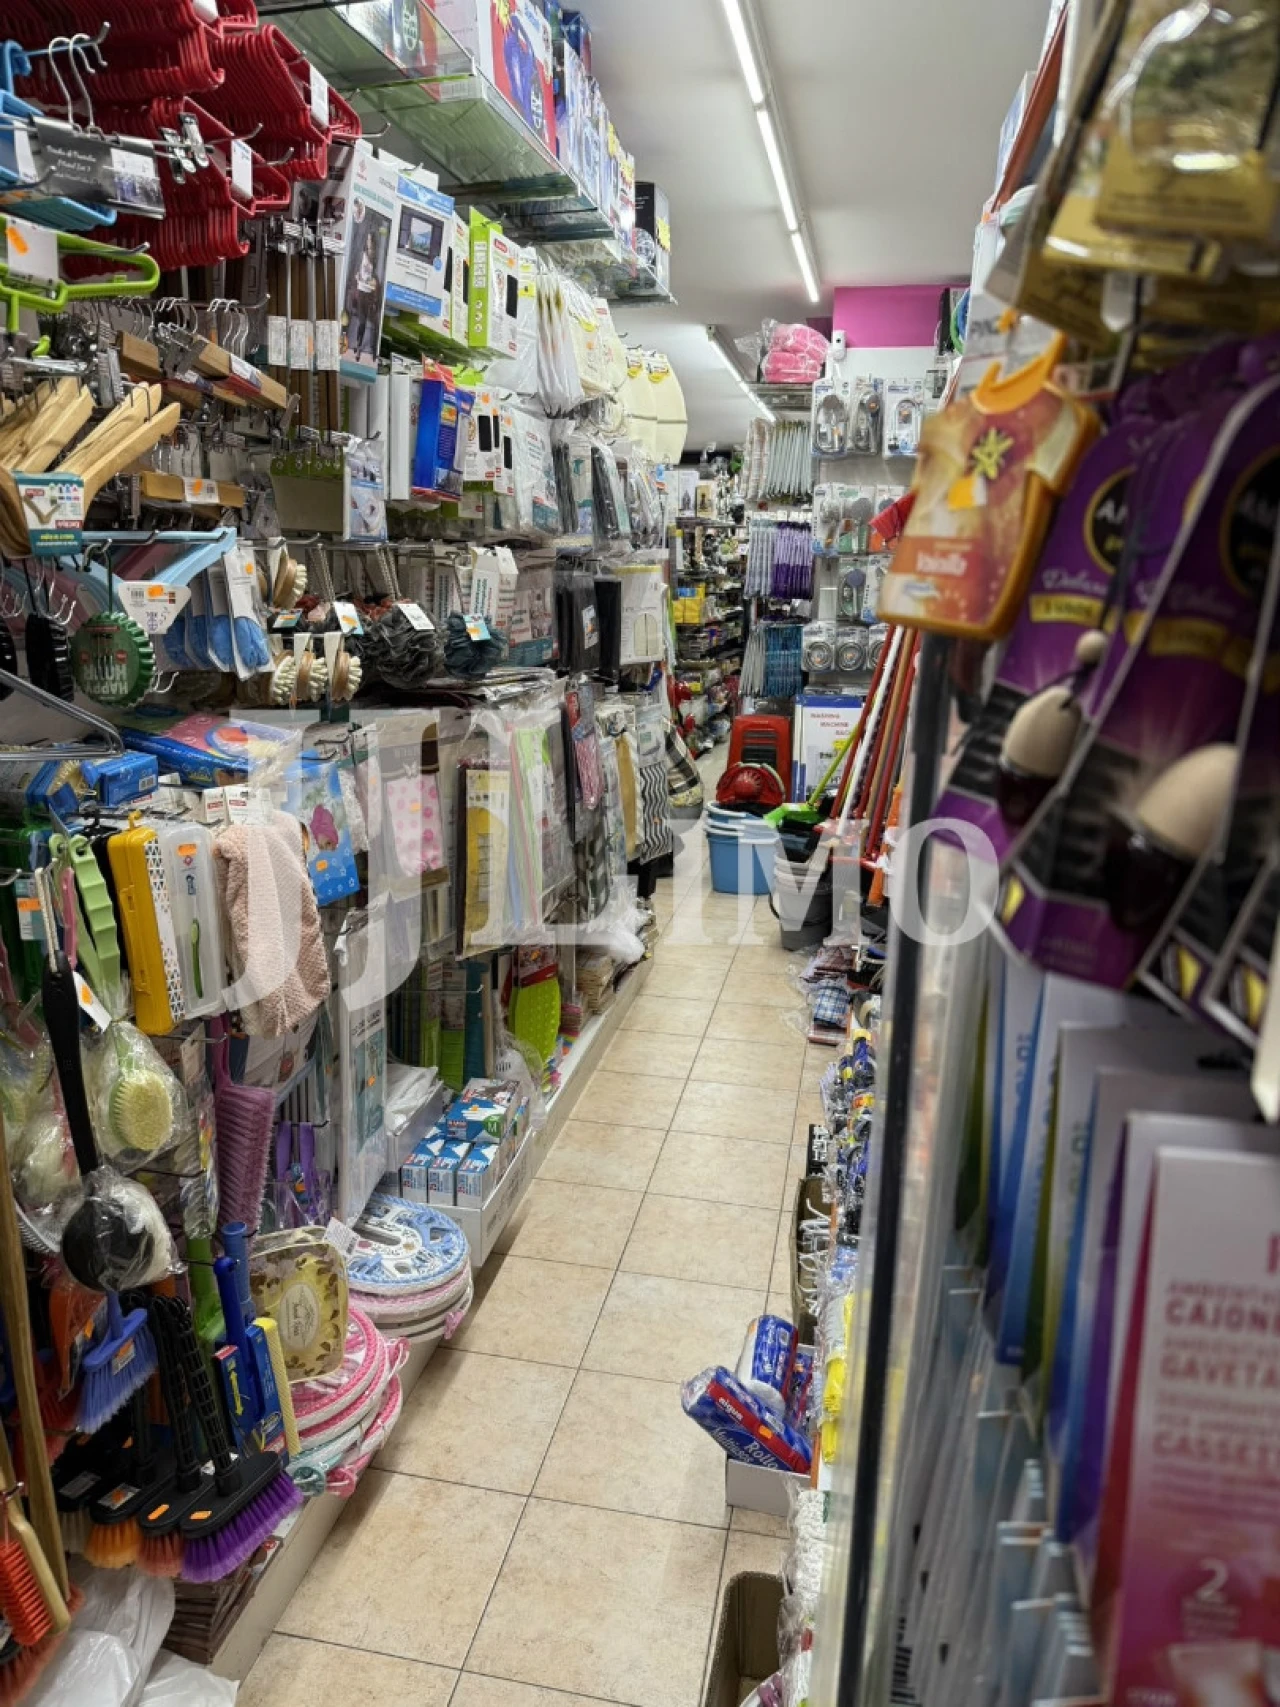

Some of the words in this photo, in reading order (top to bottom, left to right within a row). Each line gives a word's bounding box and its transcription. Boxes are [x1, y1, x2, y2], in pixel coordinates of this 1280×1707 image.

[84, 681, 129, 695] HAPPY
[744, 1440, 779, 1470] Rollo
[1196, 1558, 1229, 1603] 2
